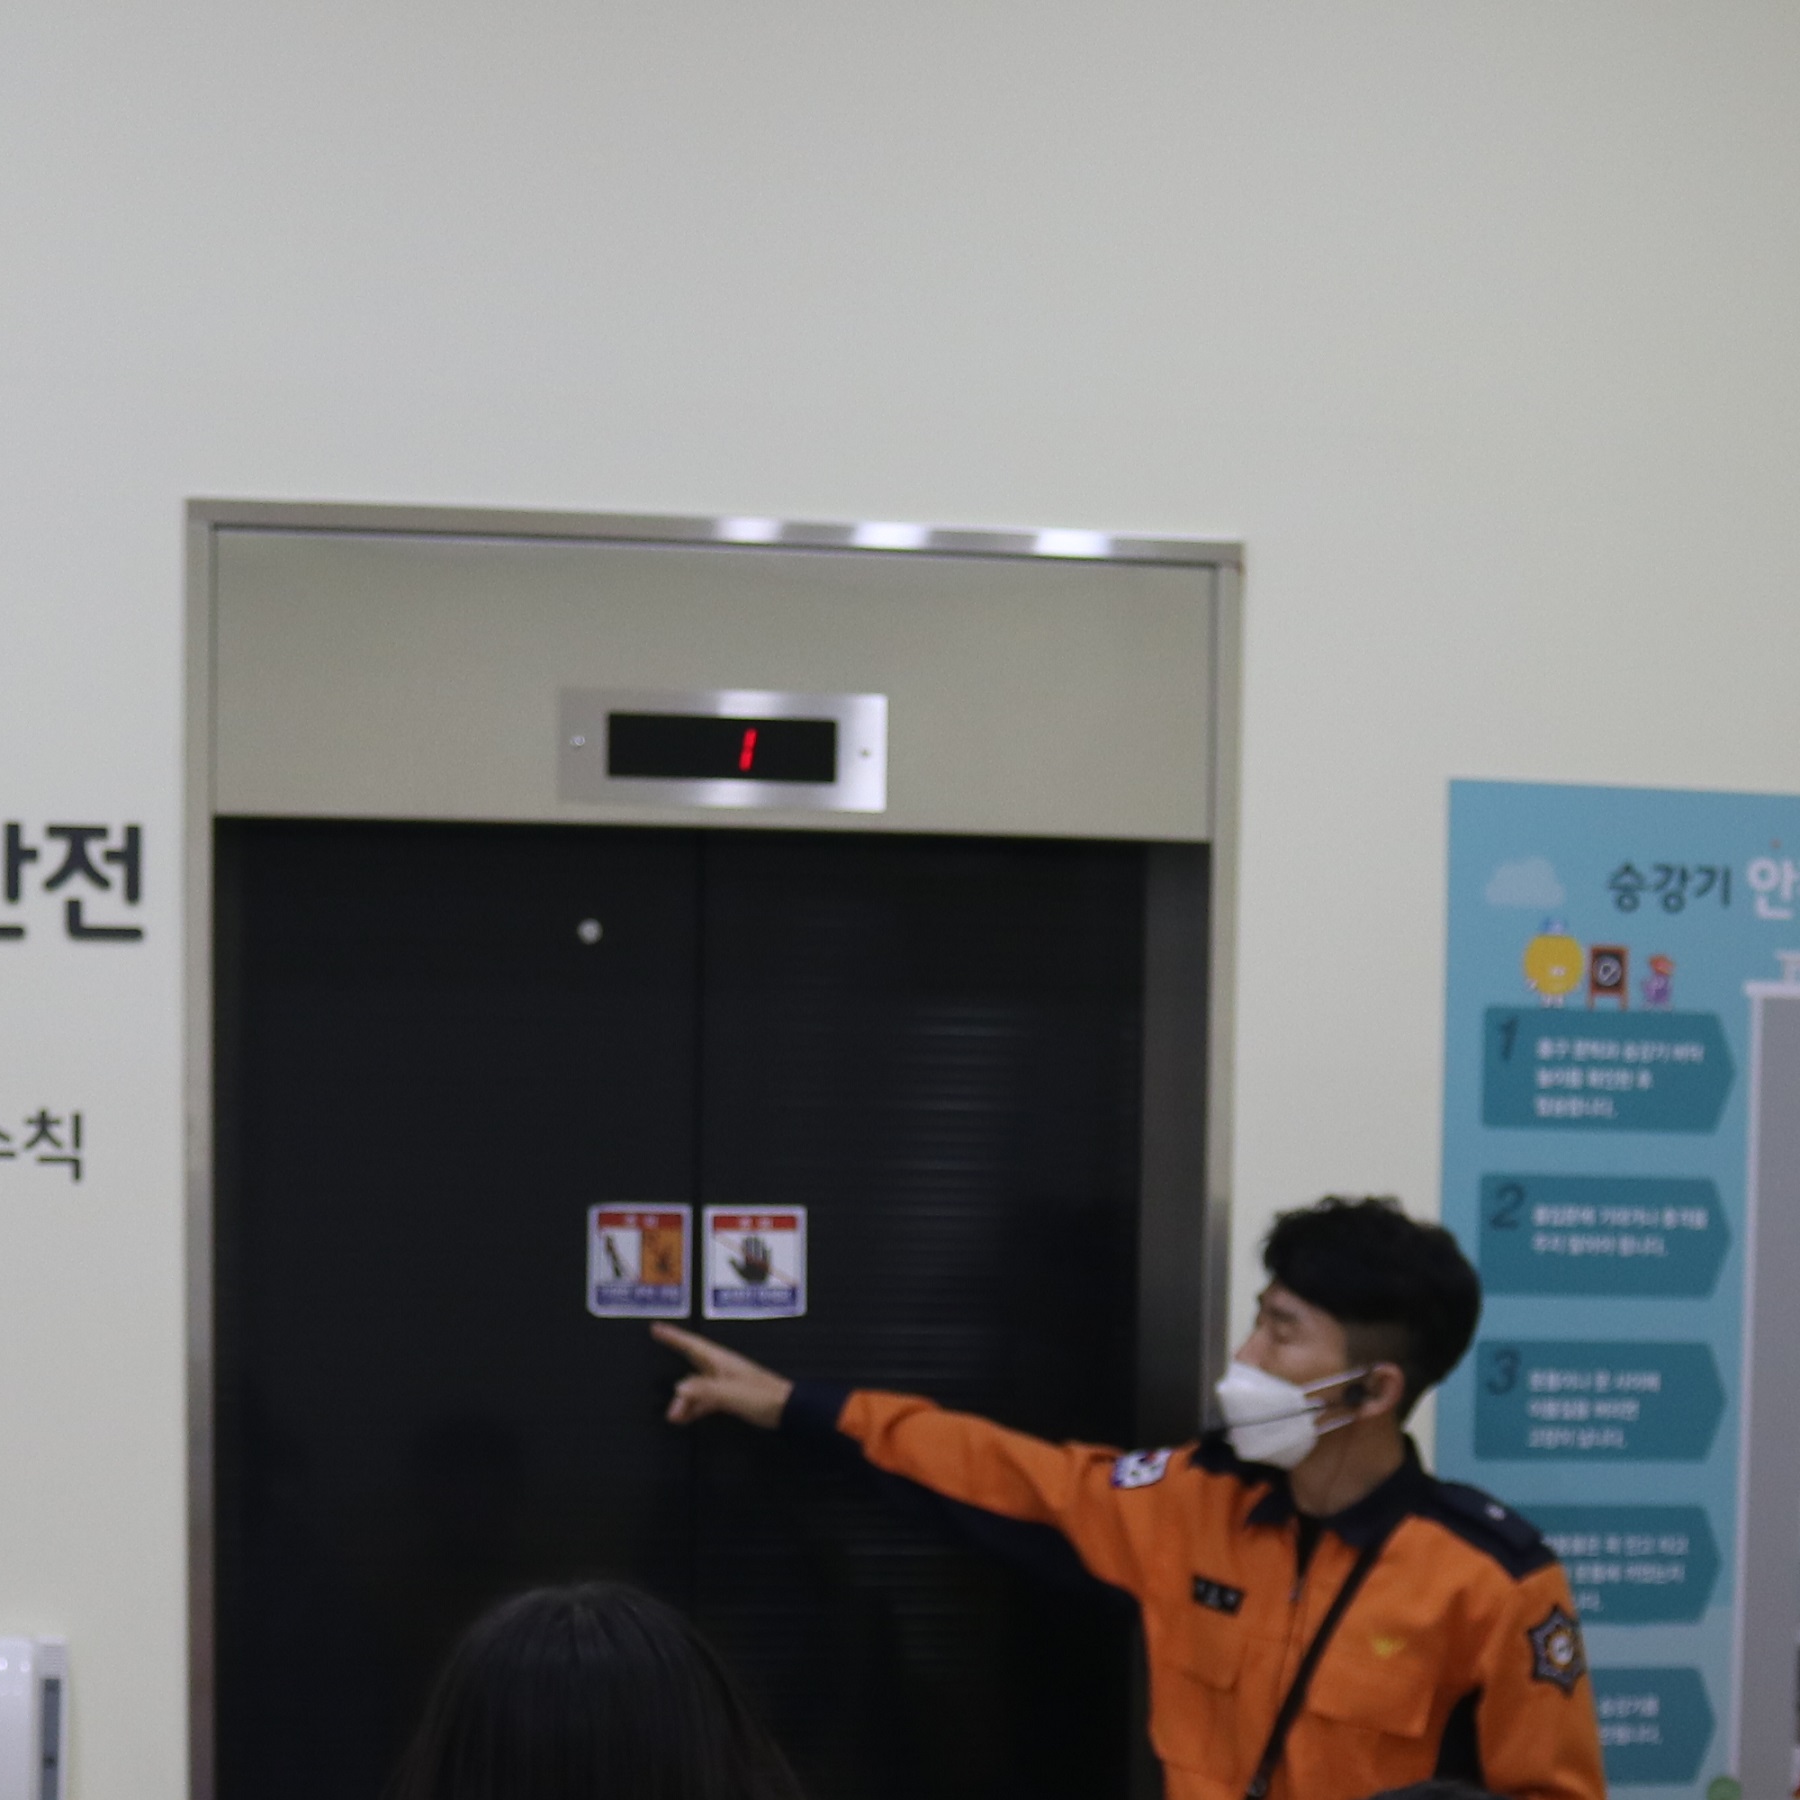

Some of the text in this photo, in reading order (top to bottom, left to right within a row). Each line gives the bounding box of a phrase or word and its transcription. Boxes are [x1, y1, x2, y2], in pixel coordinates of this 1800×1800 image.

[739, 727, 758, 772] 1
[1608, 861, 1732, 914] 승강기
[1490, 1183, 1525, 1230] 2
[1486, 1349, 1521, 1395] 3
